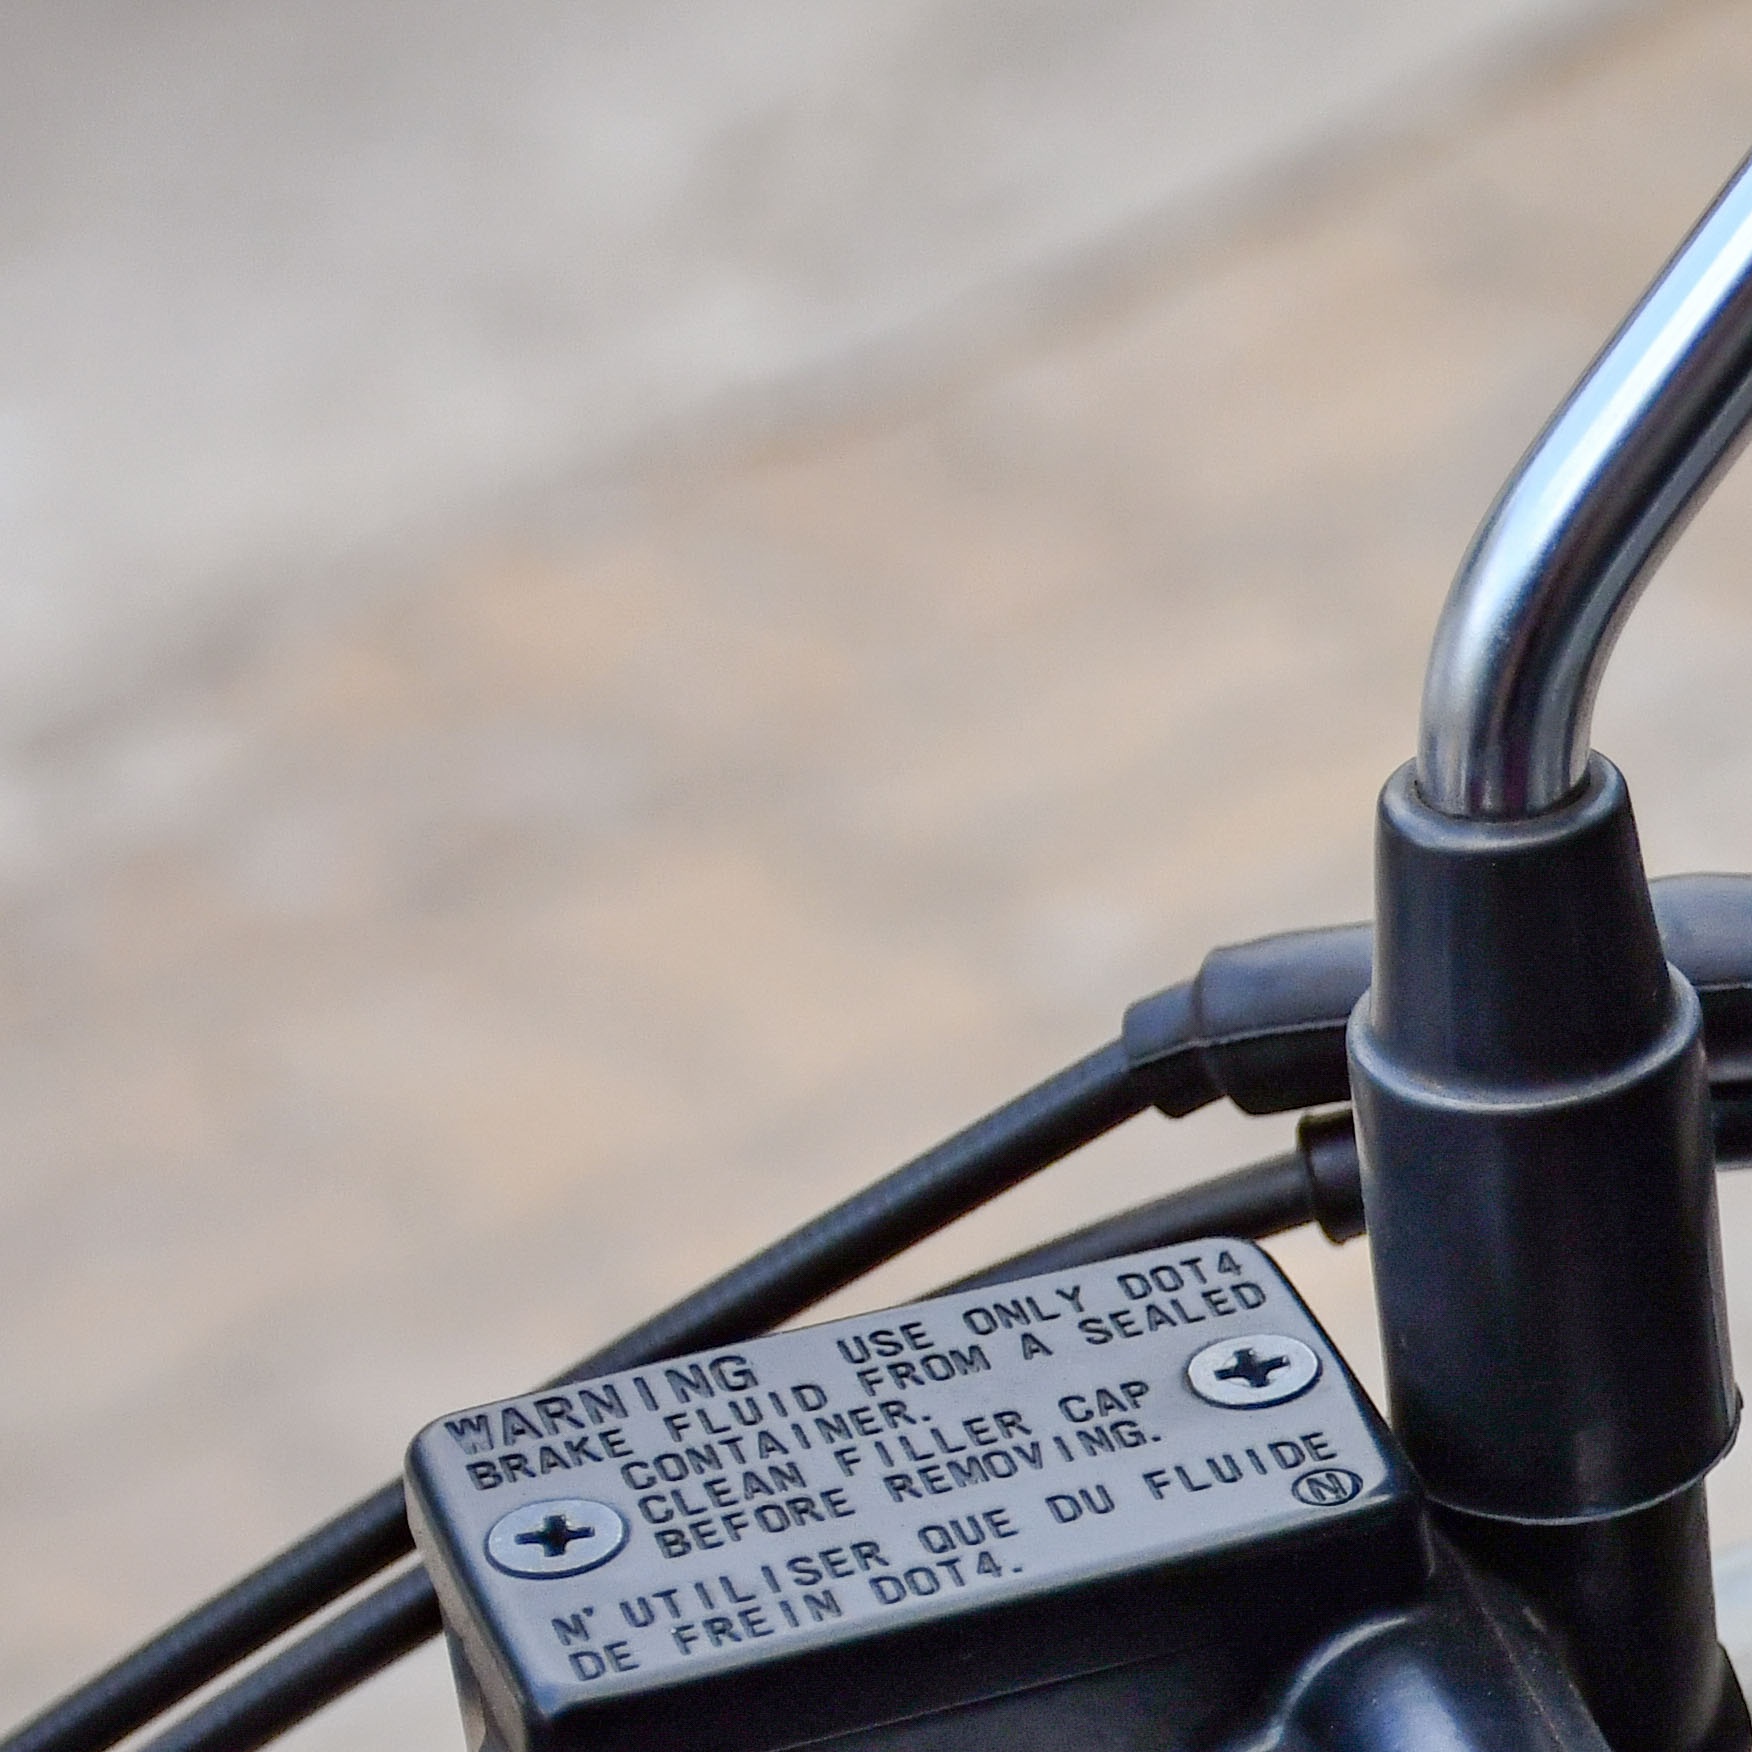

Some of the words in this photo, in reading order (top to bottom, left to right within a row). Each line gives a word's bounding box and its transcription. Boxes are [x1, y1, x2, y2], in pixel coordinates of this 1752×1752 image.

[837, 1321, 934, 1365] USE
[962, 1285, 1086, 1338] ONLY
[1117, 1250, 1243, 1302] DOT4
[445, 1355, 758, 1455] WARNING
[466, 1428, 633, 1491] BRAKE
[664, 1384, 828, 1443] FLUID
[857, 1345, 991, 1397] FROM
[1021, 1332, 1053, 1361] A
[1078, 1281, 1267, 1346] SEALED
[620, 1400, 932, 1492] CONTAINER.
[638, 1462, 807, 1525] CLEAN
[833, 1410, 1032, 1477] FILLER
[1057, 1380, 1150, 1425] CAP
[654, 1488, 856, 1560] BEFORE
[883, 1419, 1162, 1504] REMOVING.
[917, 1508, 1019, 1554] QUE
[1045, 1484, 1115, 1523] DU
[1142, 1432, 1337, 1500] FLUIDE
[568, 1640, 639, 1682] DE
[672, 1589, 843, 1656] FREIN
[869, 1550, 1023, 1606] DOT4.
